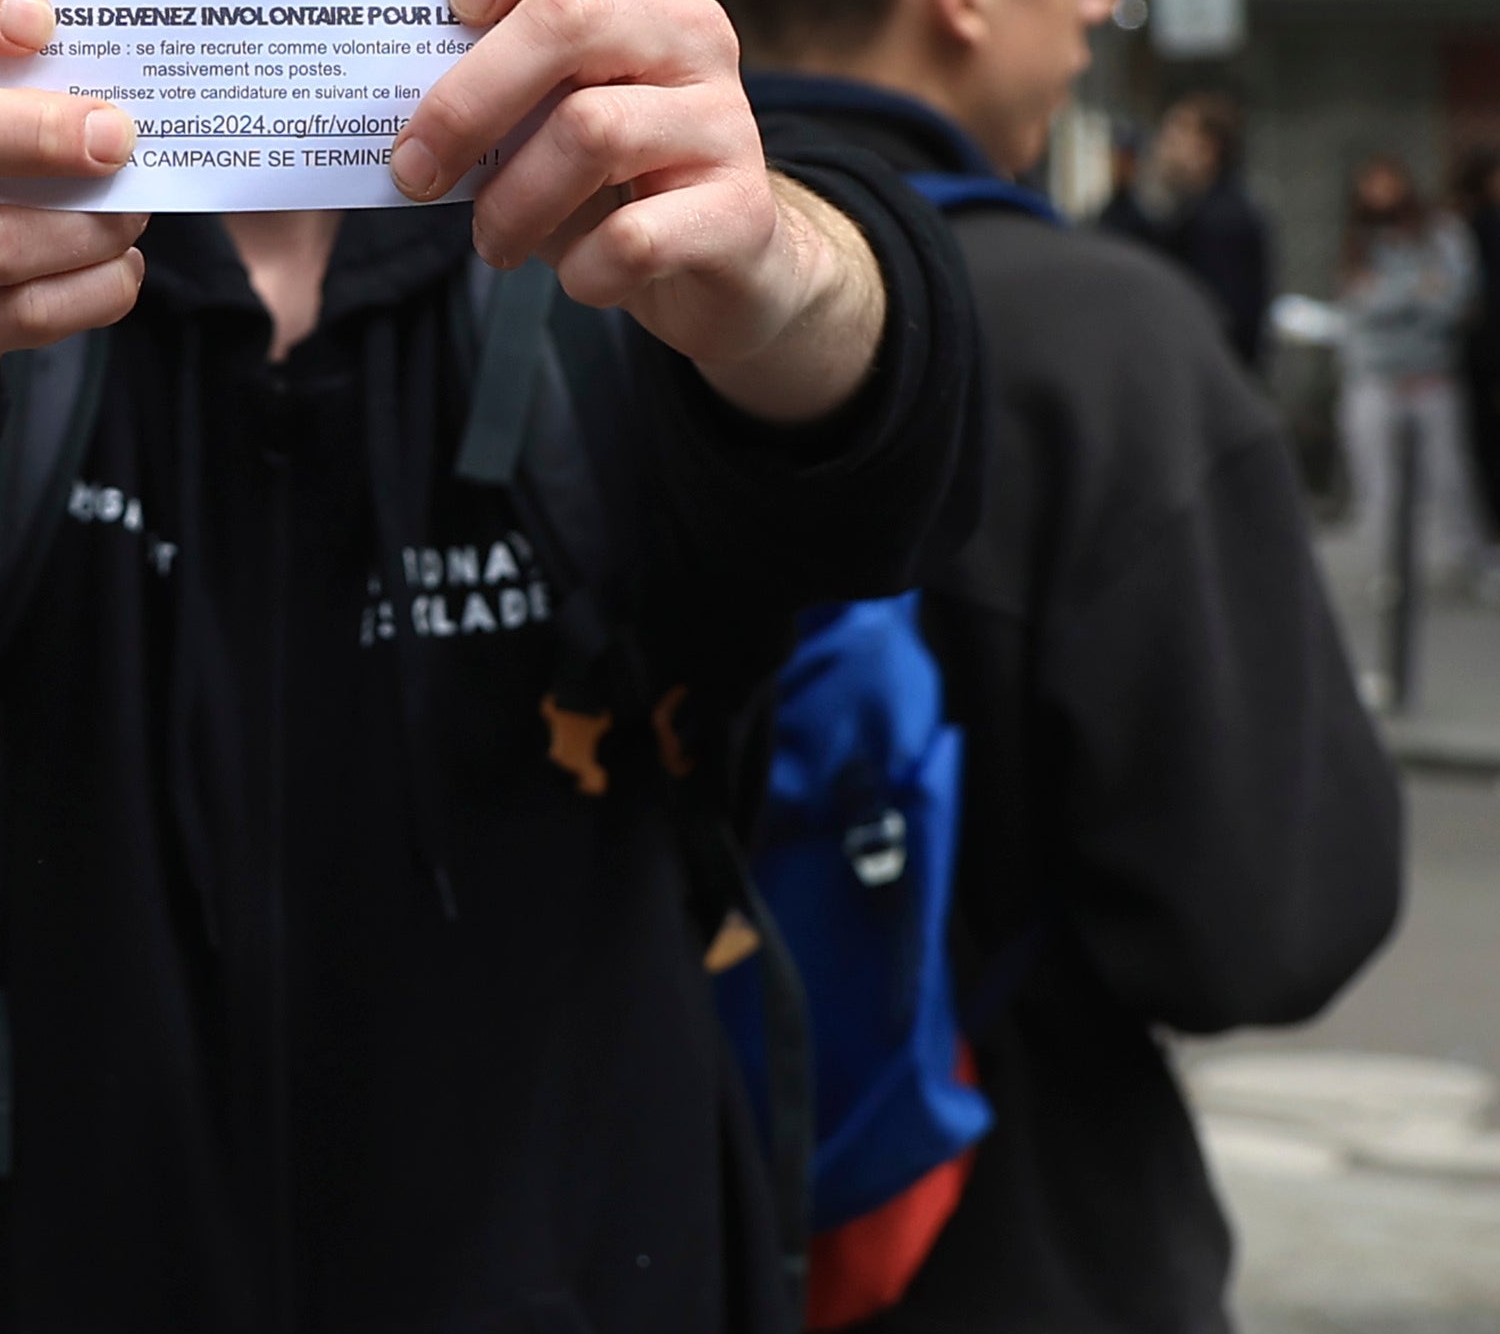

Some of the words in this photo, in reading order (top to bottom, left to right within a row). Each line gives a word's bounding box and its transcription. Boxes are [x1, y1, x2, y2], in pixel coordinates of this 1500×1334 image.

[99, 7, 197, 26] DEVENEZ
[201, 7, 364, 26] INVOLONTAIRE
[368, 7, 432, 25] POUR
[68, 40, 121, 59] simple
[136, 43, 156, 55] se
[160, 40, 195, 55] faire
[201, 42, 264, 55] recruter
[268, 44, 327, 55] comme
[332, 40, 411, 55] volontaire
[416, 42, 432, 55] et
[142, 61, 250, 76] massivement
[254, 64, 284, 76] nos
[288, 61, 347, 79] postes.
[69, 85, 154, 100] Remplissez
[159, 87, 196, 99] votre
[200, 85, 288, 99] candidature
[292, 88, 310, 99] en
[314, 85, 369, 99] suivant
[372, 88, 390, 99] ce
[394, 85, 421, 99] lien
[134, 114, 410, 139] w.paris2024.org/fr/volont
[142, 151, 261, 167] CAMPAGNE
[267, 151, 296, 167] SE
[301, 149, 392, 166] TERMINE
